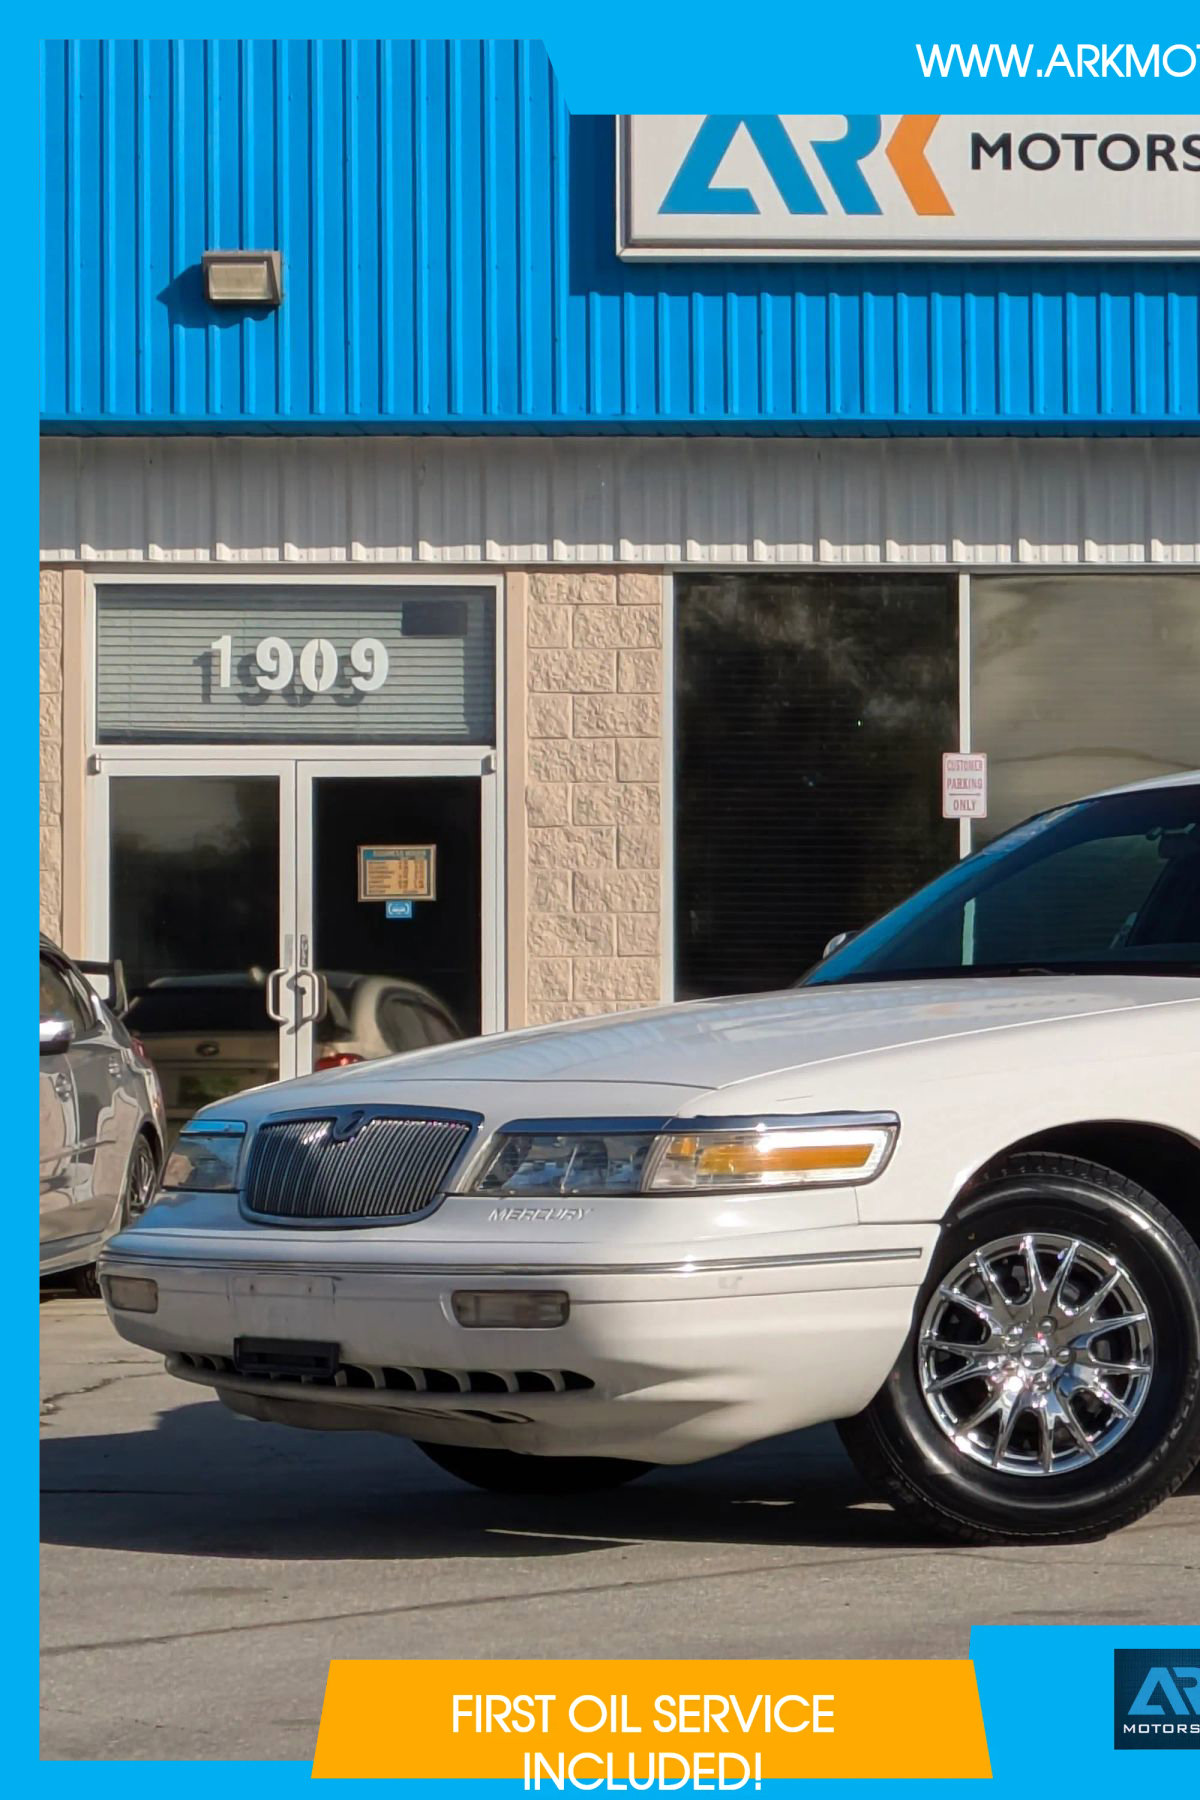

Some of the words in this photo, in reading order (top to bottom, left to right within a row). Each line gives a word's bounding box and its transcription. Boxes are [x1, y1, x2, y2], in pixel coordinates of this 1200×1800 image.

[659, 115, 956, 216] ARK
[211, 635, 390, 692] 1909
[946, 759, 983, 772] CUSTOMER
[946, 778, 983, 790] PARKING
[953, 799, 977, 811] ONLY
[487, 1207, 595, 1221] MERCURY
